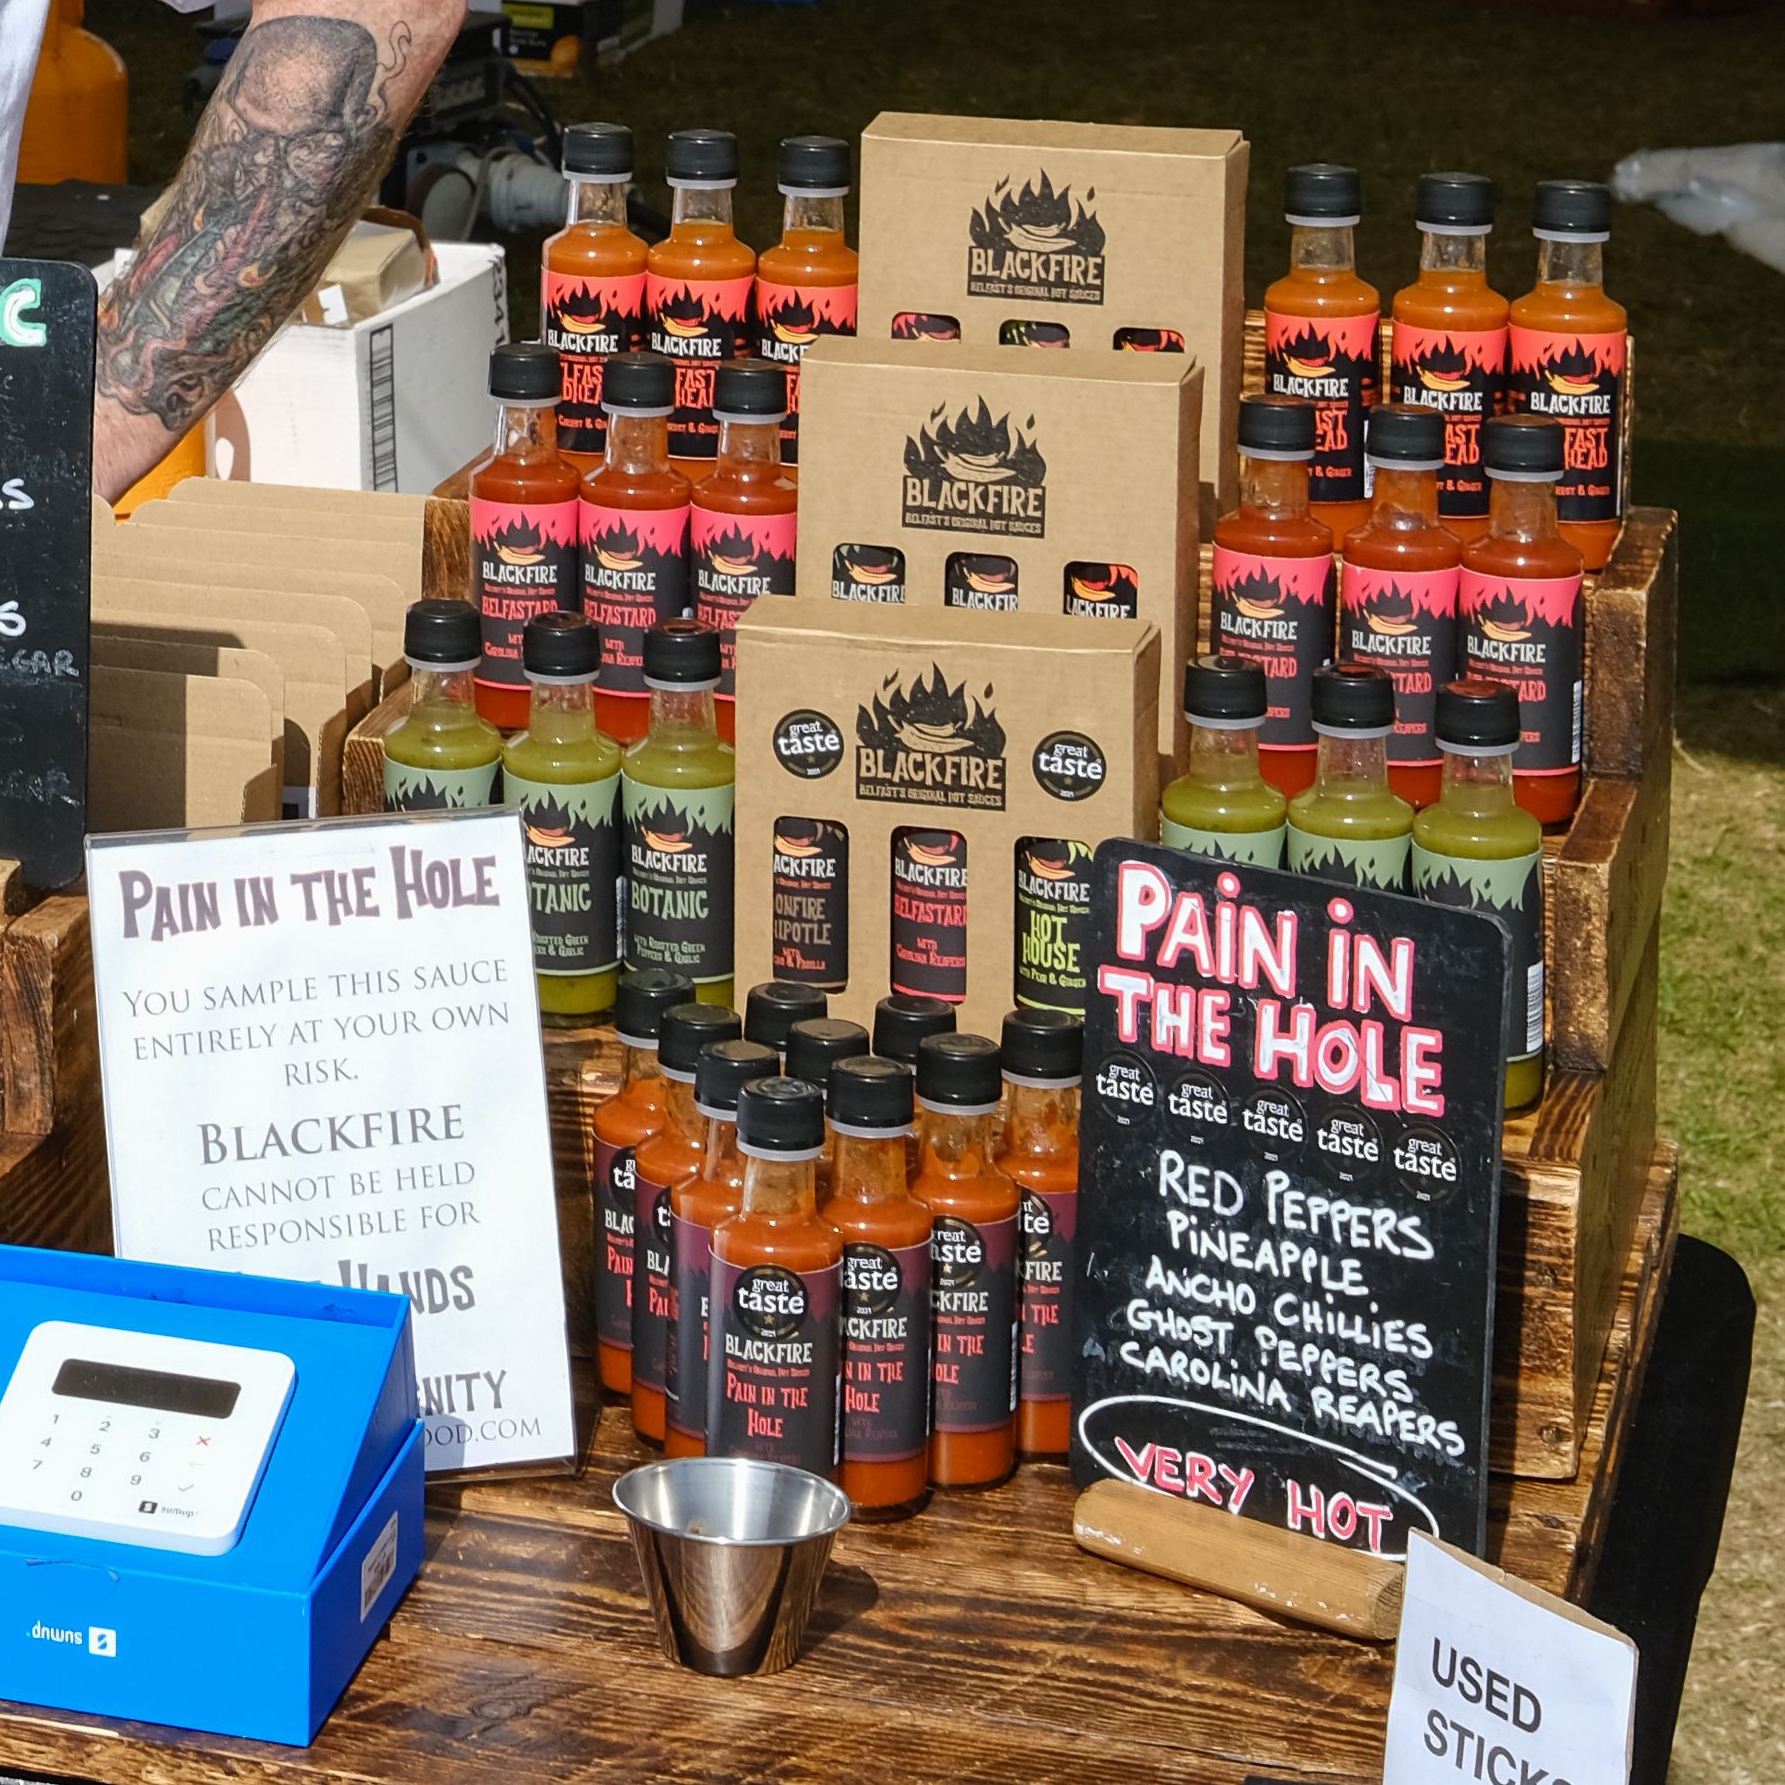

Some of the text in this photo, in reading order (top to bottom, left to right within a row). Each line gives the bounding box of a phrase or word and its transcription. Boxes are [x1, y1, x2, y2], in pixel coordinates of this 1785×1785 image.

[971, 248, 1102, 286] BLACKFIRE
[548, 330, 619, 353] BLACKFIRE
[651, 331, 722, 357] BLACKFIRE
[1273, 374, 1349, 398] BLACKFIRE
[1403, 385, 1483, 412] BLACKFIRE
[1530, 393, 1611, 415] BLACKFIRE
[905, 478, 1043, 518] BLACKFIRE
[482, 561, 558, 584] BLACKFIRE
[584, 563, 656, 591] BLACKFIRE
[698, 569, 772, 596] BLACKFIRE
[1220, 612, 1298, 640] BLACKFIRE
[1351, 629, 1432, 656] BLACKFIRE
[1467, 635, 1547, 664] BLACKFIRE
[778, 733, 840, 756] taste
[859, 748, 1003, 790] BLACKFIRE
[1039, 753, 1103, 780] taste
[631, 844, 708, 873] BLACKFIRE
[118, 845, 501, 943] PAIN IN THE HOLE
[1018, 869, 1090, 903] BLACKFIRE
[631, 888, 709, 920] BOTANIC
[1030, 910, 1067, 945] HOT
[1022, 932, 1080, 973] HOUSE
[122, 958, 509, 1018] YOU SAMPLE THIS SAUCE
[133, 1001, 510, 1061] ENTIRELY AT YOUR OWN
[1098, 964, 1445, 1118] THE HOLE
[283, 1057, 360, 1088] RISK.
[1096, 1073, 1154, 1106] taste
[1168, 1092, 1228, 1124] taste
[196, 1104, 465, 1166] BLACKFIRE
[1241, 1108, 1304, 1142] taste
[1317, 1127, 1379, 1162] taste
[1393, 1146, 1457, 1182] taste
[201, 1161, 476, 1213] CANNOT BE HELD
[1159, 1147, 1435, 1262] RED PEPPERS
[207, 1201, 481, 1252] RESPONSIBLE FOR
[737, 1287, 804, 1314] taste
[751, 1278, 789, 1293] great
[1145, 1253, 1257, 1320] ANCHO
[725, 1333, 813, 1364] BLACKFIRE
[1126, 1296, 1415, 1403] GHOST PEPPERS
[726, 1372, 808, 1409] PAIN IN THE
[53, 1414, 60, 1424] 1
[99, 1421, 111, 1432] 2
[149, 1428, 160, 1439] 3
[747, 1408, 783, 1438] HOLE
[1312, 1382, 1467, 1457] REAPERS
[41, 1437, 52, 1447] 4
[90, 1444, 101, 1454] 5
[139, 1451, 151, 1462] 6
[32, 1460, 43, 1470] 7
[80, 1467, 92, 1478] 8
[130, 1475, 142, 1486] 9
[71, 1490, 83, 1502] 0
[1115, 1434, 1394, 1555] VERY HOT
[1431, 1636, 1542, 1734] USED
